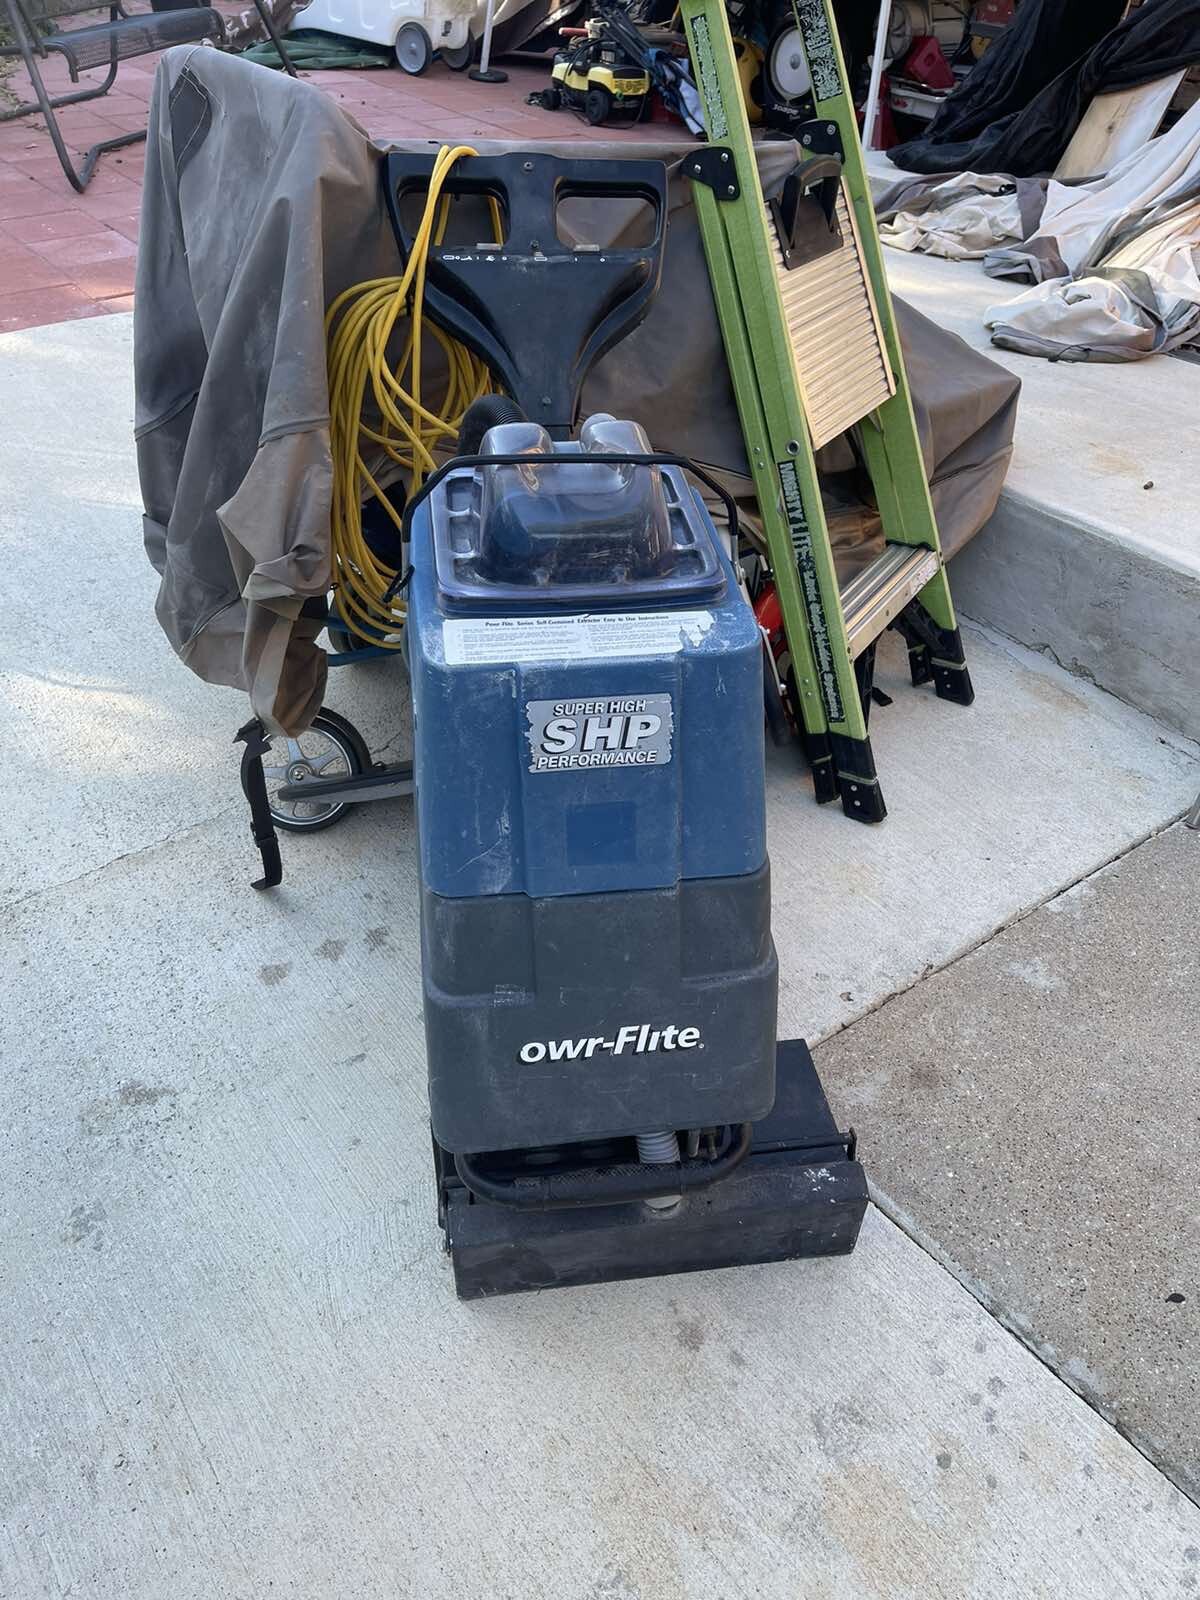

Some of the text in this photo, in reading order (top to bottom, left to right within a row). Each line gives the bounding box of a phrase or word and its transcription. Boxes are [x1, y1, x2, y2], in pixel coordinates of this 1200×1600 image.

[779, 462, 804, 520] MIGHTY
[553, 699, 647, 717] SUPER HIGH
[540, 714, 662, 754] SHP
[536, 749, 658, 770] PERFORMANCE
